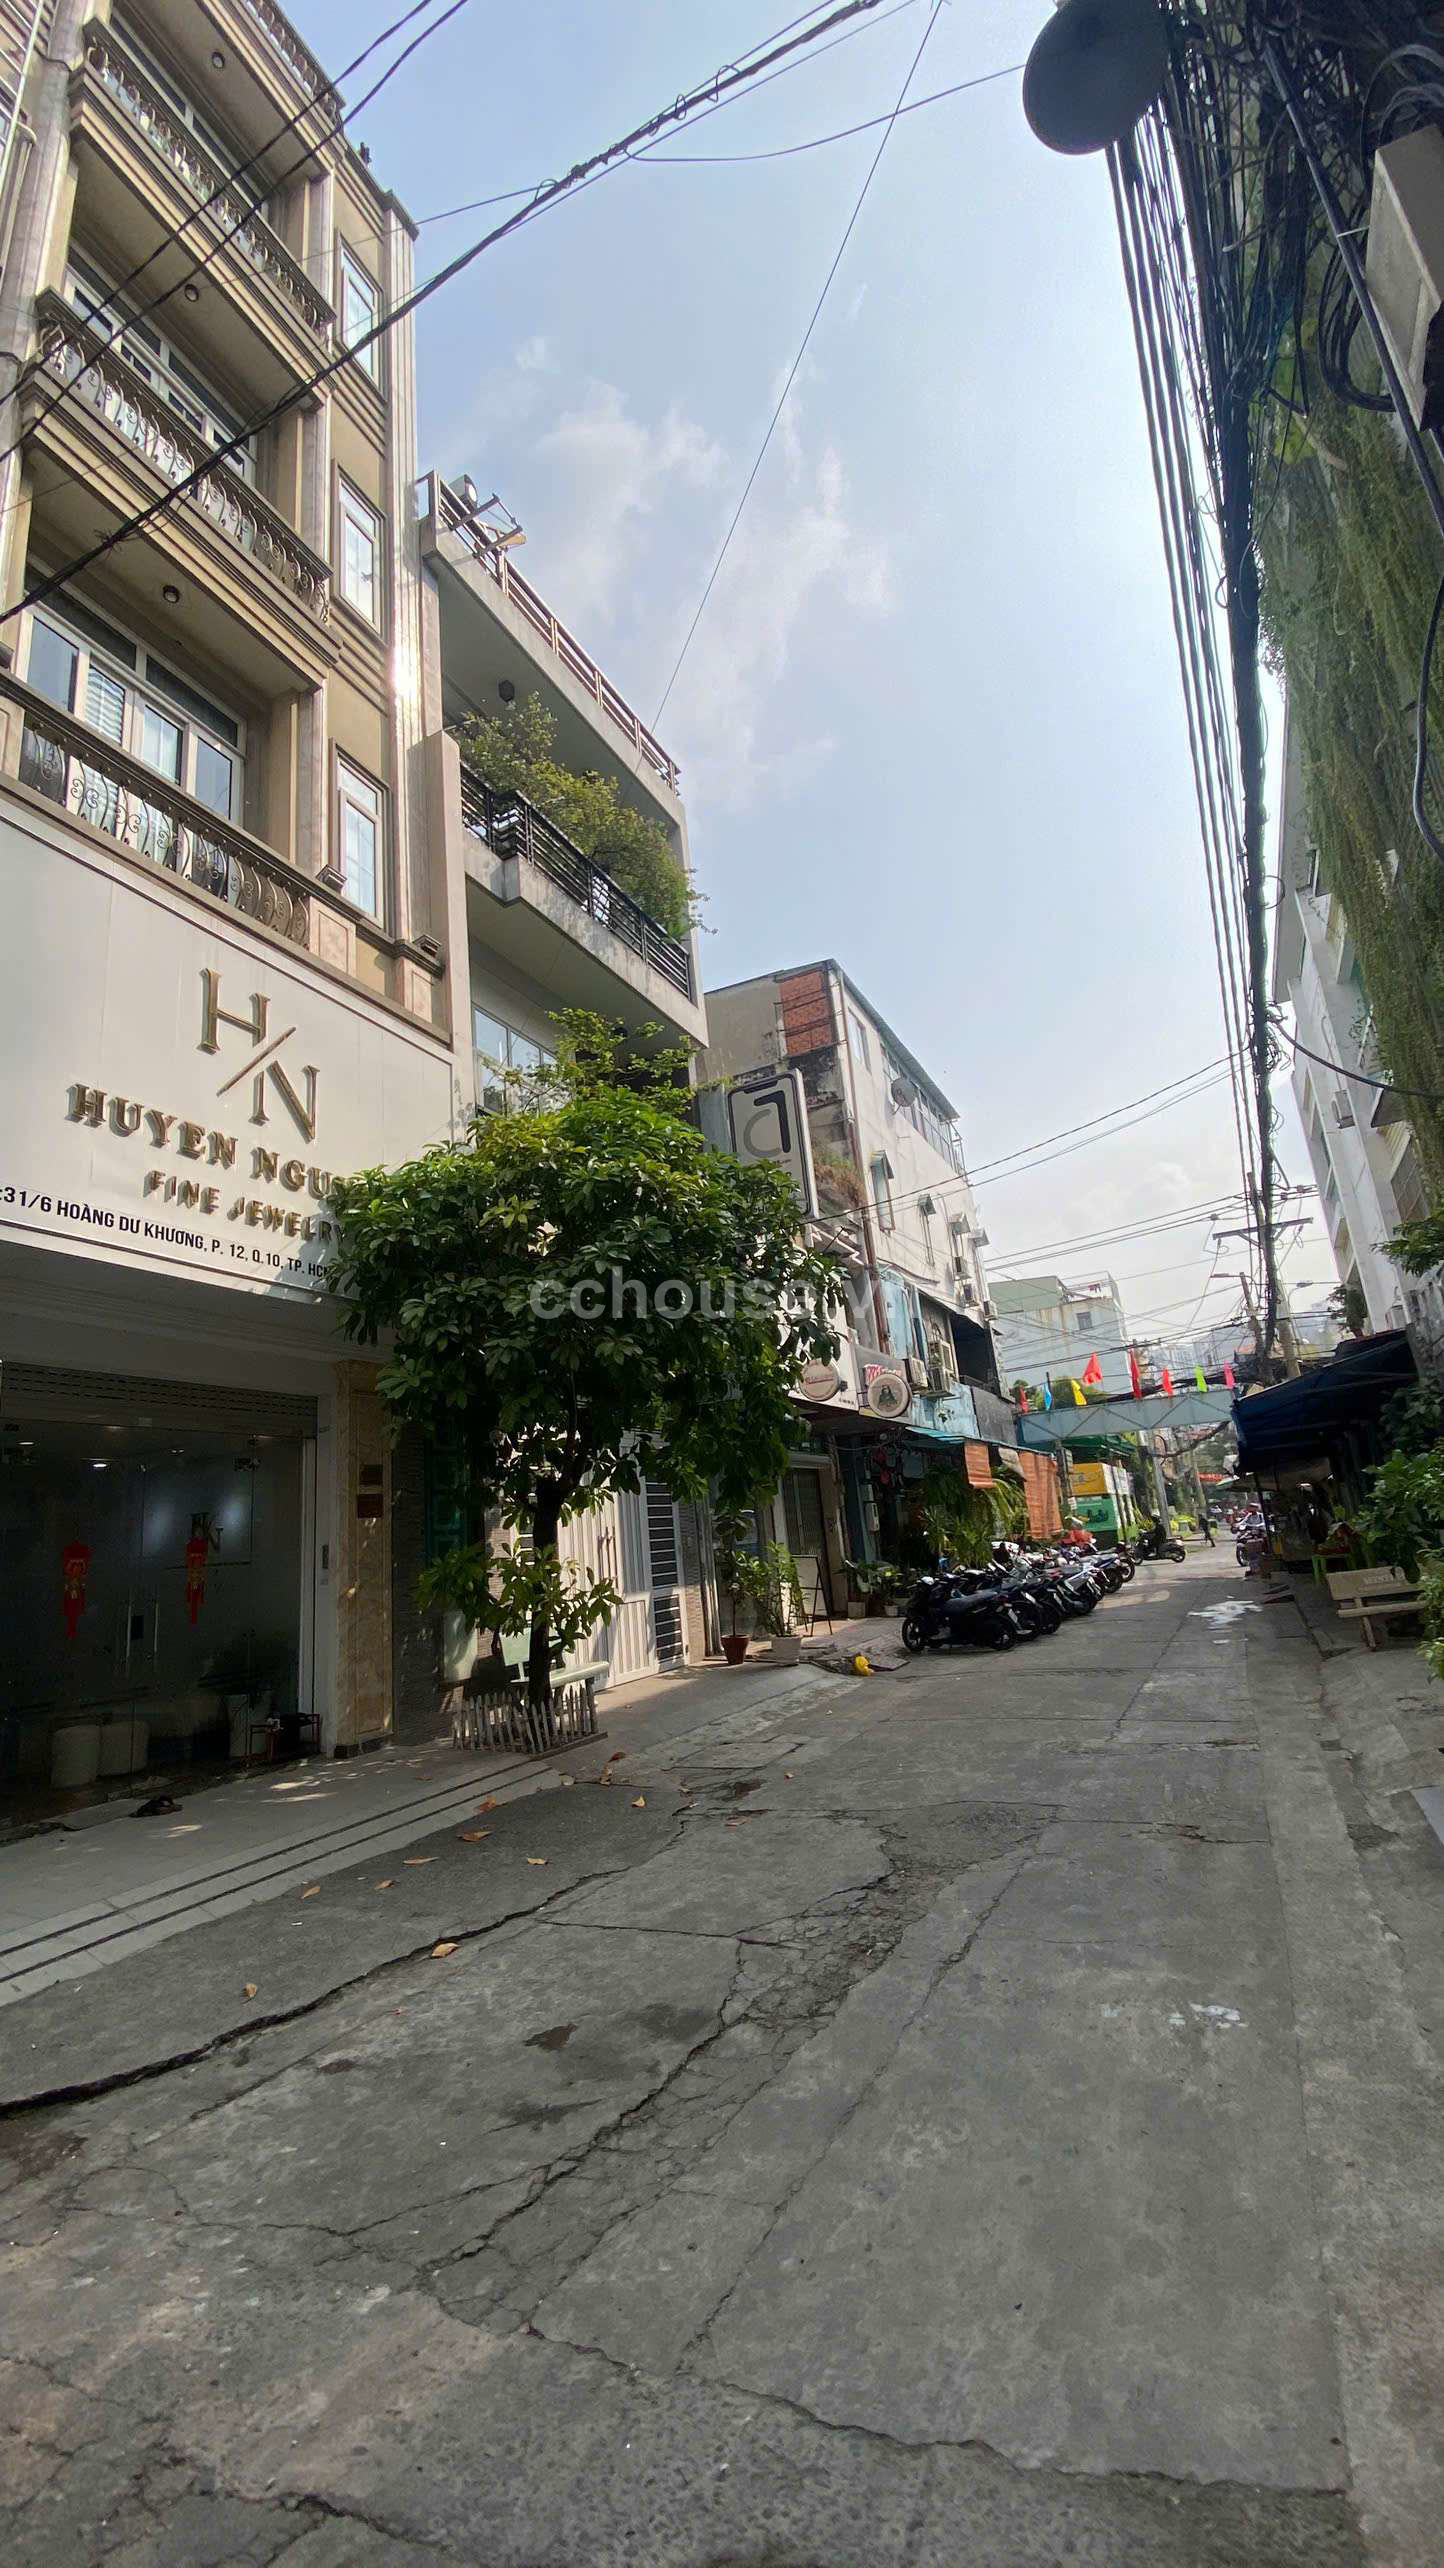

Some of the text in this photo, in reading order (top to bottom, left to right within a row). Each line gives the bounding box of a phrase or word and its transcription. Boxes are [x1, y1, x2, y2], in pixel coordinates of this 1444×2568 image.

[65, 1083, 337, 1201] HUYEN NGU
[143, 1170, 221, 1215] FINE
[56, 1200, 114, 1228] HOÀNG
[119, 1215, 141, 1234] DƯ
